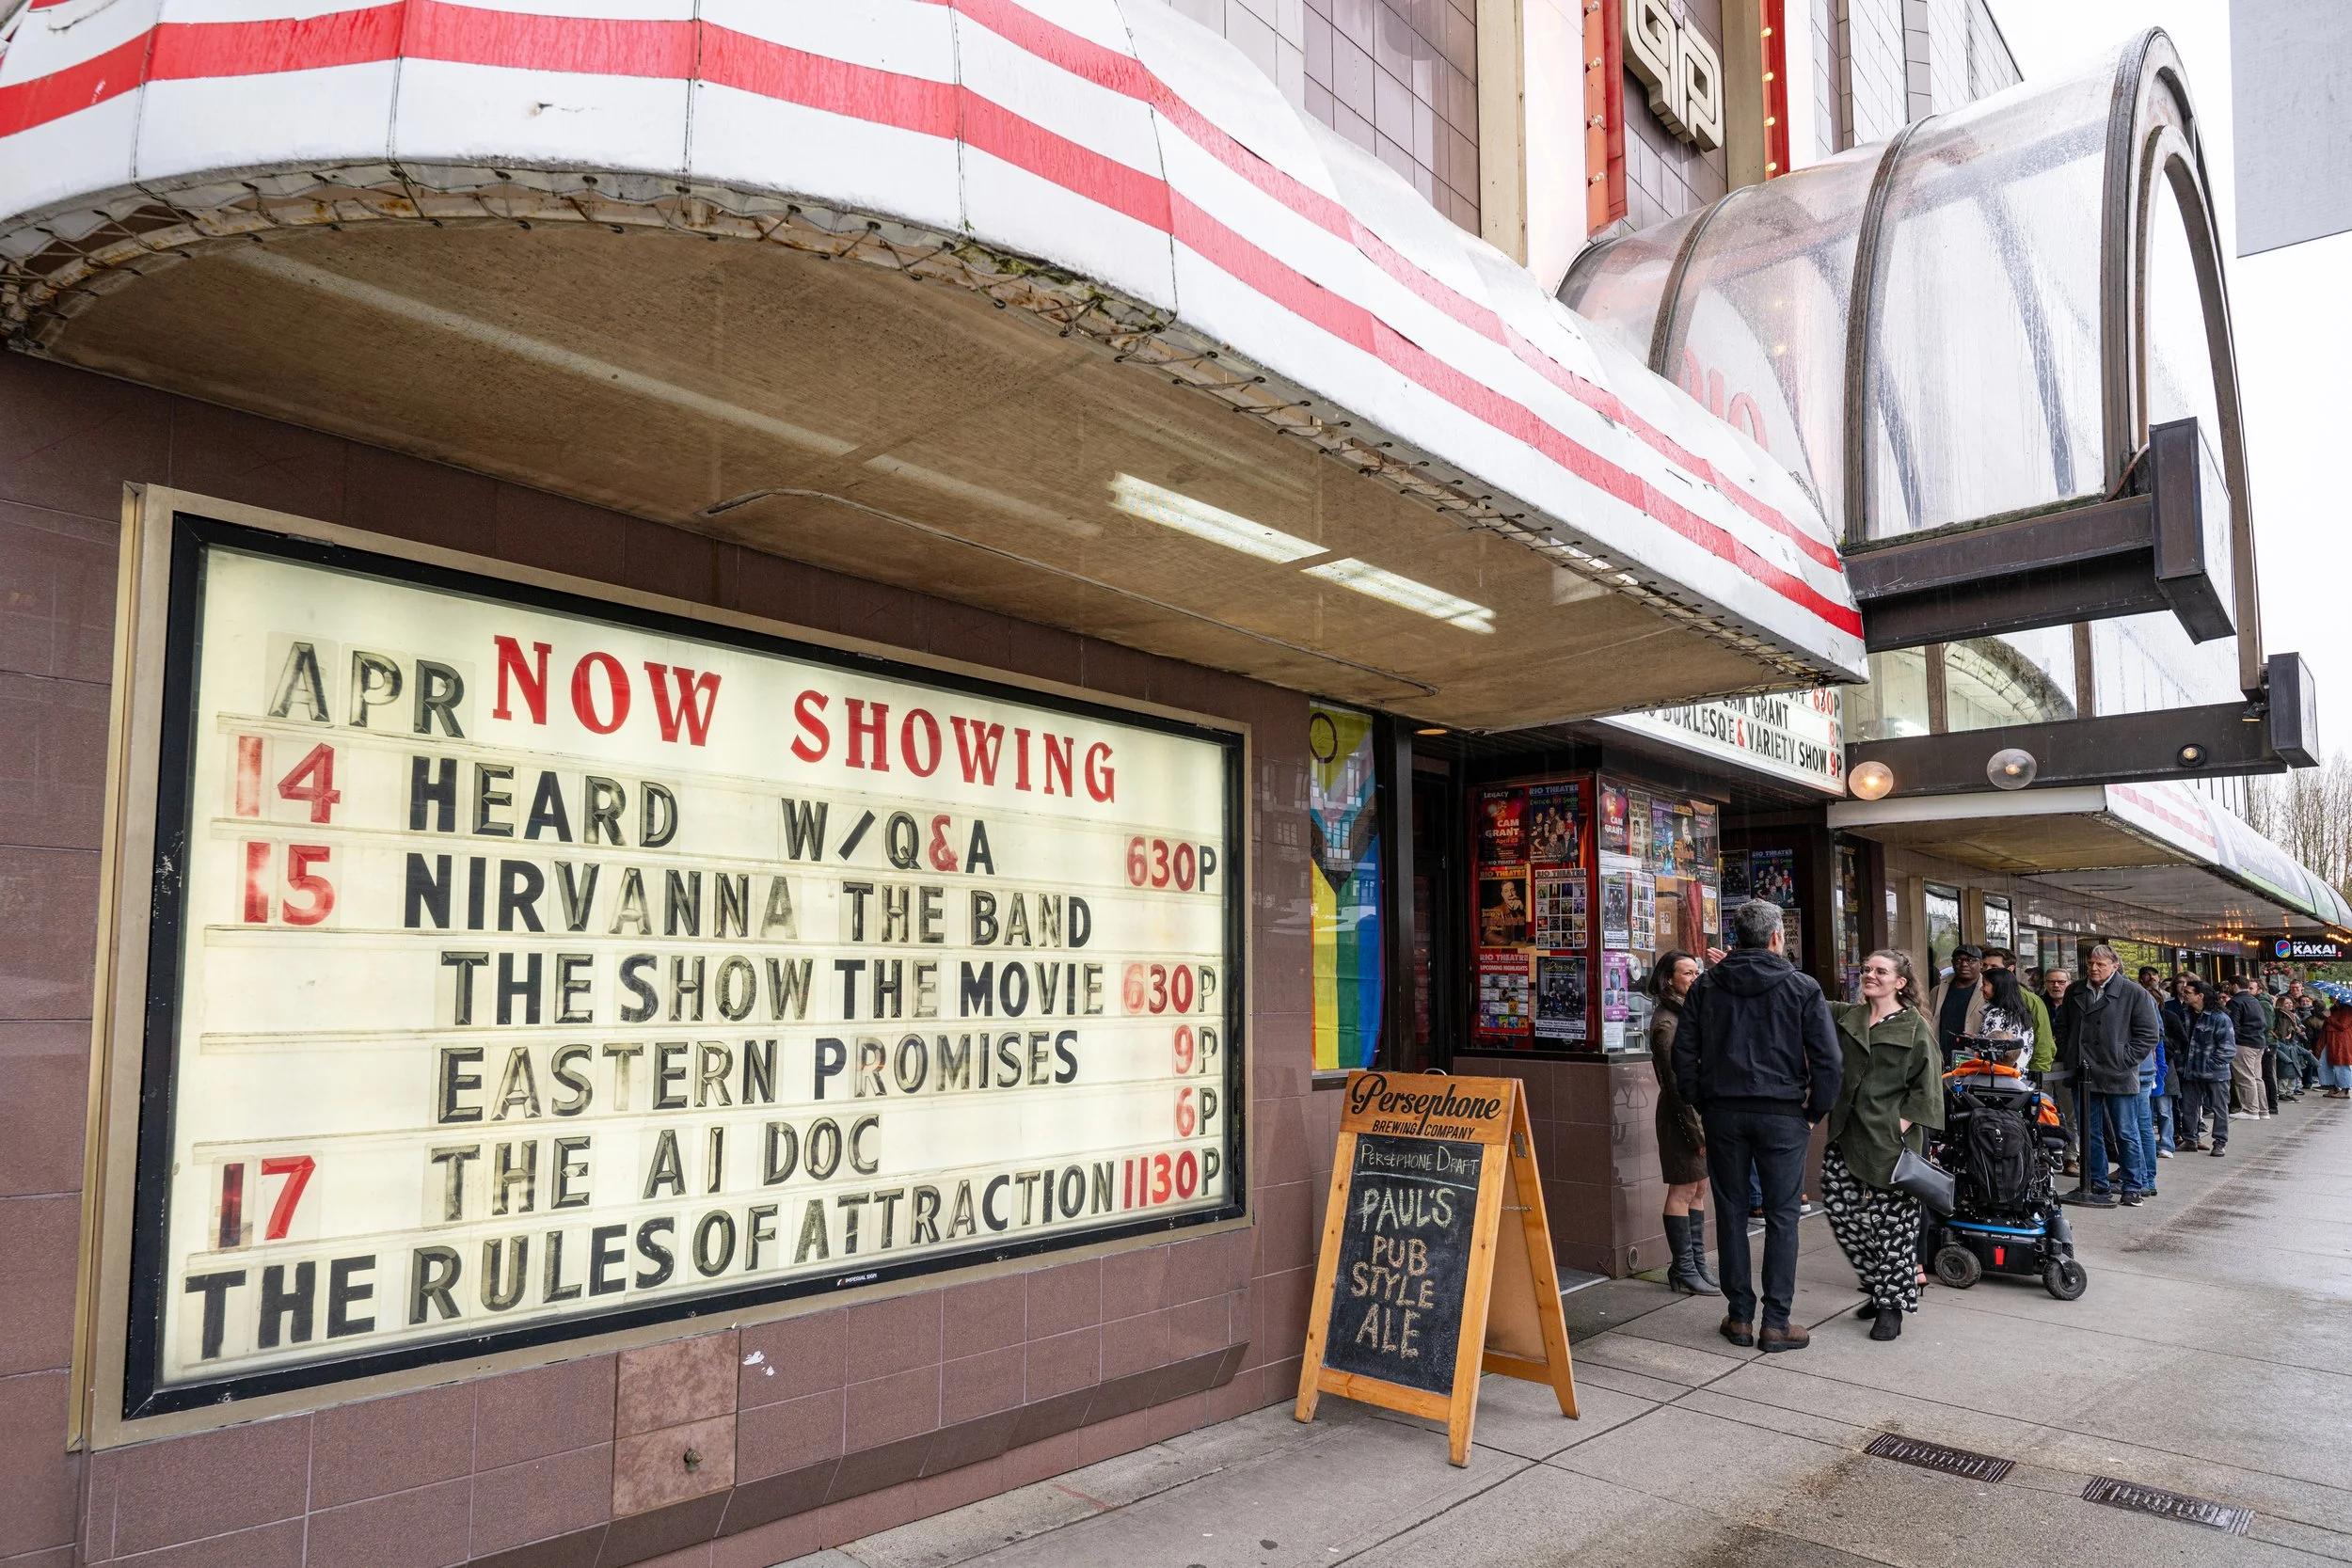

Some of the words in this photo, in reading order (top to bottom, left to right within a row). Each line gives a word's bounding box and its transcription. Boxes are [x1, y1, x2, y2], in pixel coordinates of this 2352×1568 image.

[268, 641, 465, 738] APR
[1754, 696, 1788, 729] GRANT
[493, 635, 722, 747] NOW
[790, 689, 1115, 803] SHOWING
[1747, 721, 1795, 763] VARIETY
[1799, 741, 1827, 773] SHOW
[1830, 751, 1842, 778] 9P
[235, 736, 341, 824] 14
[409, 755, 678, 847] HEARD
[782, 798, 995, 876] W/Q&A
[1127, 835, 1217, 893] 630P
[1485, 828, 1520, 838] GRANT
[1497, 818, 1519, 828] CAM
[243, 842, 335, 926] 15
[404, 853, 798, 940] NIRVANNA
[843, 881, 945, 944] THE
[971, 890, 1091, 948] BAND
[2293, 944, 2337, 955] KAKAI
[441, 951, 594, 1026] THE
[619, 953, 814, 1023] SHOW
[834, 958, 938, 1021] THE
[961, 959, 1104, 1018] MOVIE
[1122, 963, 1217, 1015] 630P
[438, 1039, 778, 1124] EASTERN
[814, 1029, 1078, 1101] PROMISES
[1174, 1023, 1218, 1075] 9P
[1351, 1073, 1502, 1135] Persephone
[1372, 1119, 1418, 1134] BREWING
[1424, 1124, 1475, 1140] COMPANY
[218, 1155, 316, 1248] 17
[431, 1135, 593, 1222] THE
[643, 1126, 724, 1201] AI
[763, 1113, 881, 1187] DOC
[1175, 1086, 1218, 1138] 6P
[1360, 1187, 1455, 1232] PAUL'S
[185, 1254, 376, 1361] THE
[409, 1216, 675, 1325] RULES
[693, 1203, 778, 1277] OF
[794, 1149, 1114, 1259] ATTRACTION
[1124, 1147, 1221, 1210] 1130P
[1373, 1235, 1428, 1276] PUB
[1351, 1261, 1435, 1309] STYLE
[1355, 1304, 1421, 1359] ALE
